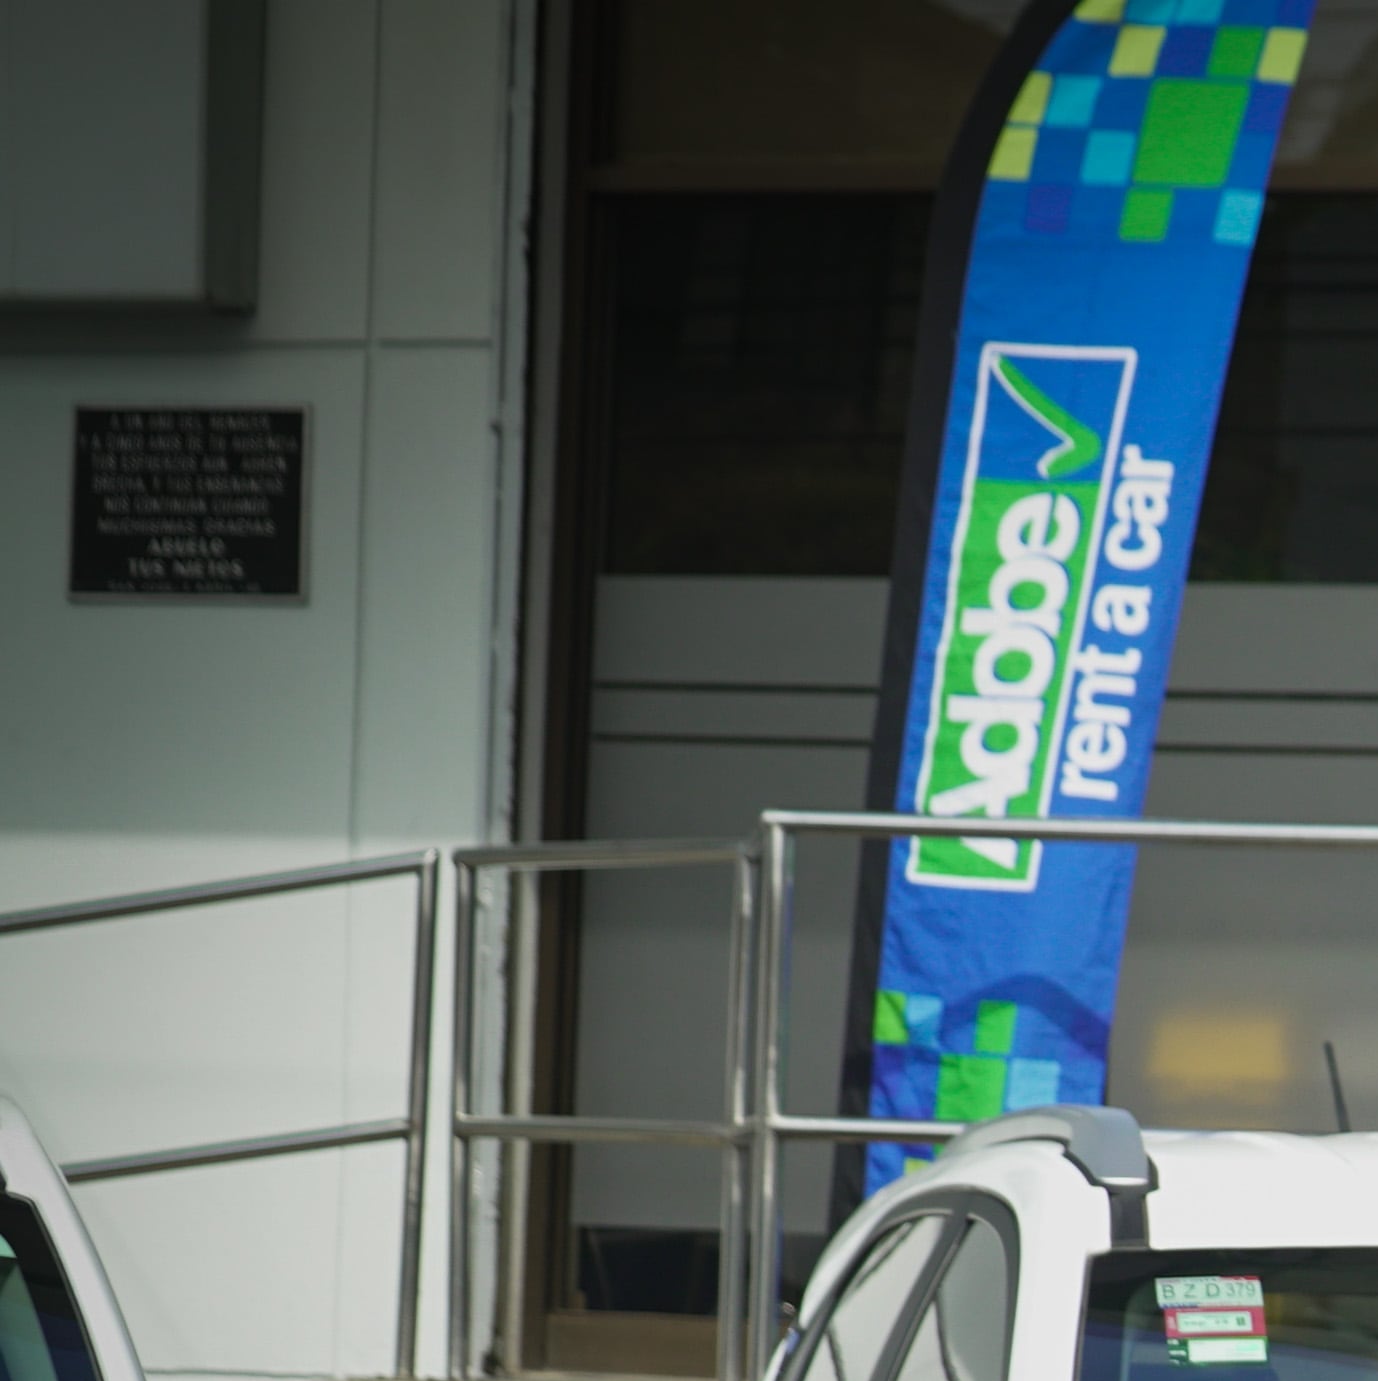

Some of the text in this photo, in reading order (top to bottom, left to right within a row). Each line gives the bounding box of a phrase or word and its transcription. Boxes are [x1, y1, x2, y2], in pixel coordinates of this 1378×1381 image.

[928, 491, 1081, 870] Adobe
[1060, 444, 1175, 801] rent a car
